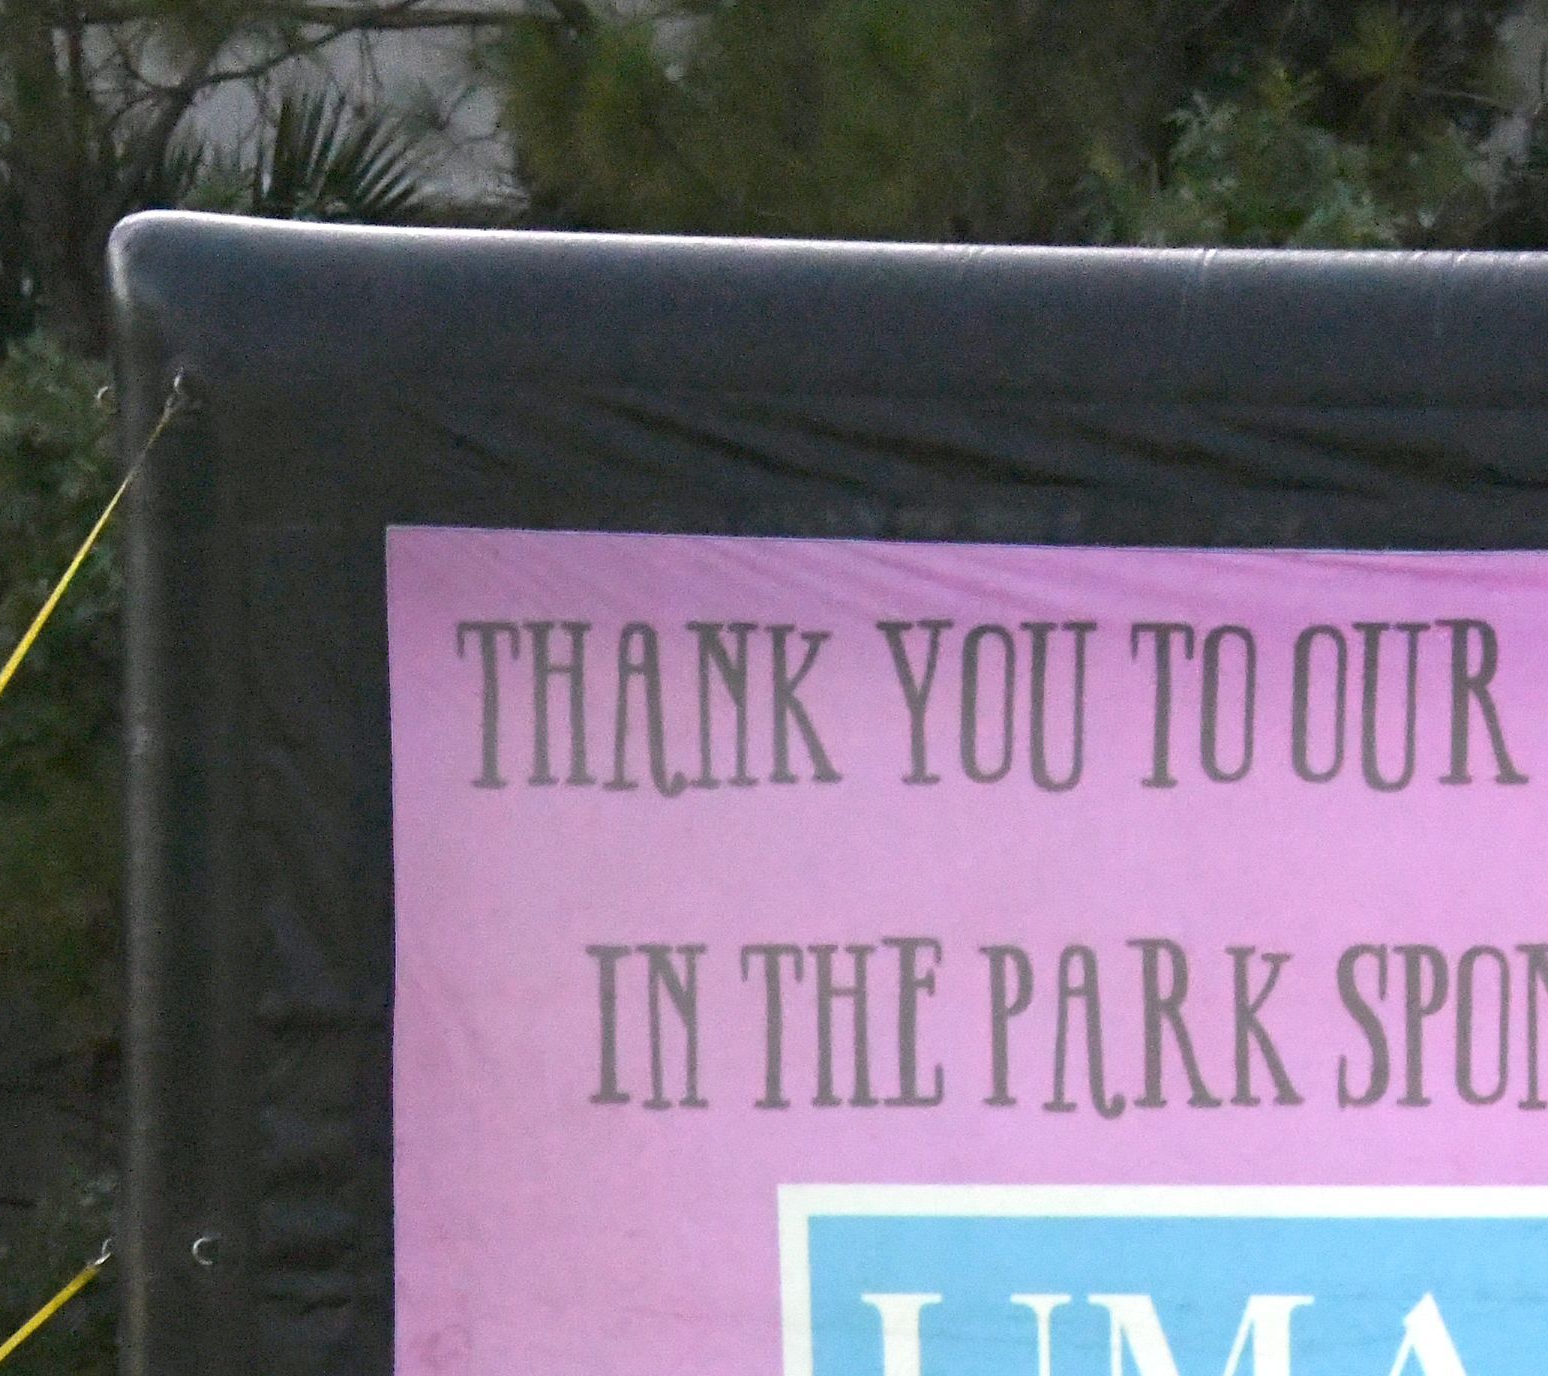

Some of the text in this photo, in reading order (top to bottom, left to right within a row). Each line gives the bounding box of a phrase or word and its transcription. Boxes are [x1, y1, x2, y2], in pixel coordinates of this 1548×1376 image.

[456, 619, 841, 797] THANK
[874, 617, 1099, 791] YOU
[1130, 619, 1259, 788] TO
[1290, 617, 1529, 792] OUR
[586, 944, 707, 1111] IN
[740, 938, 945, 1111] THE
[980, 939, 1300, 1119] PARK
